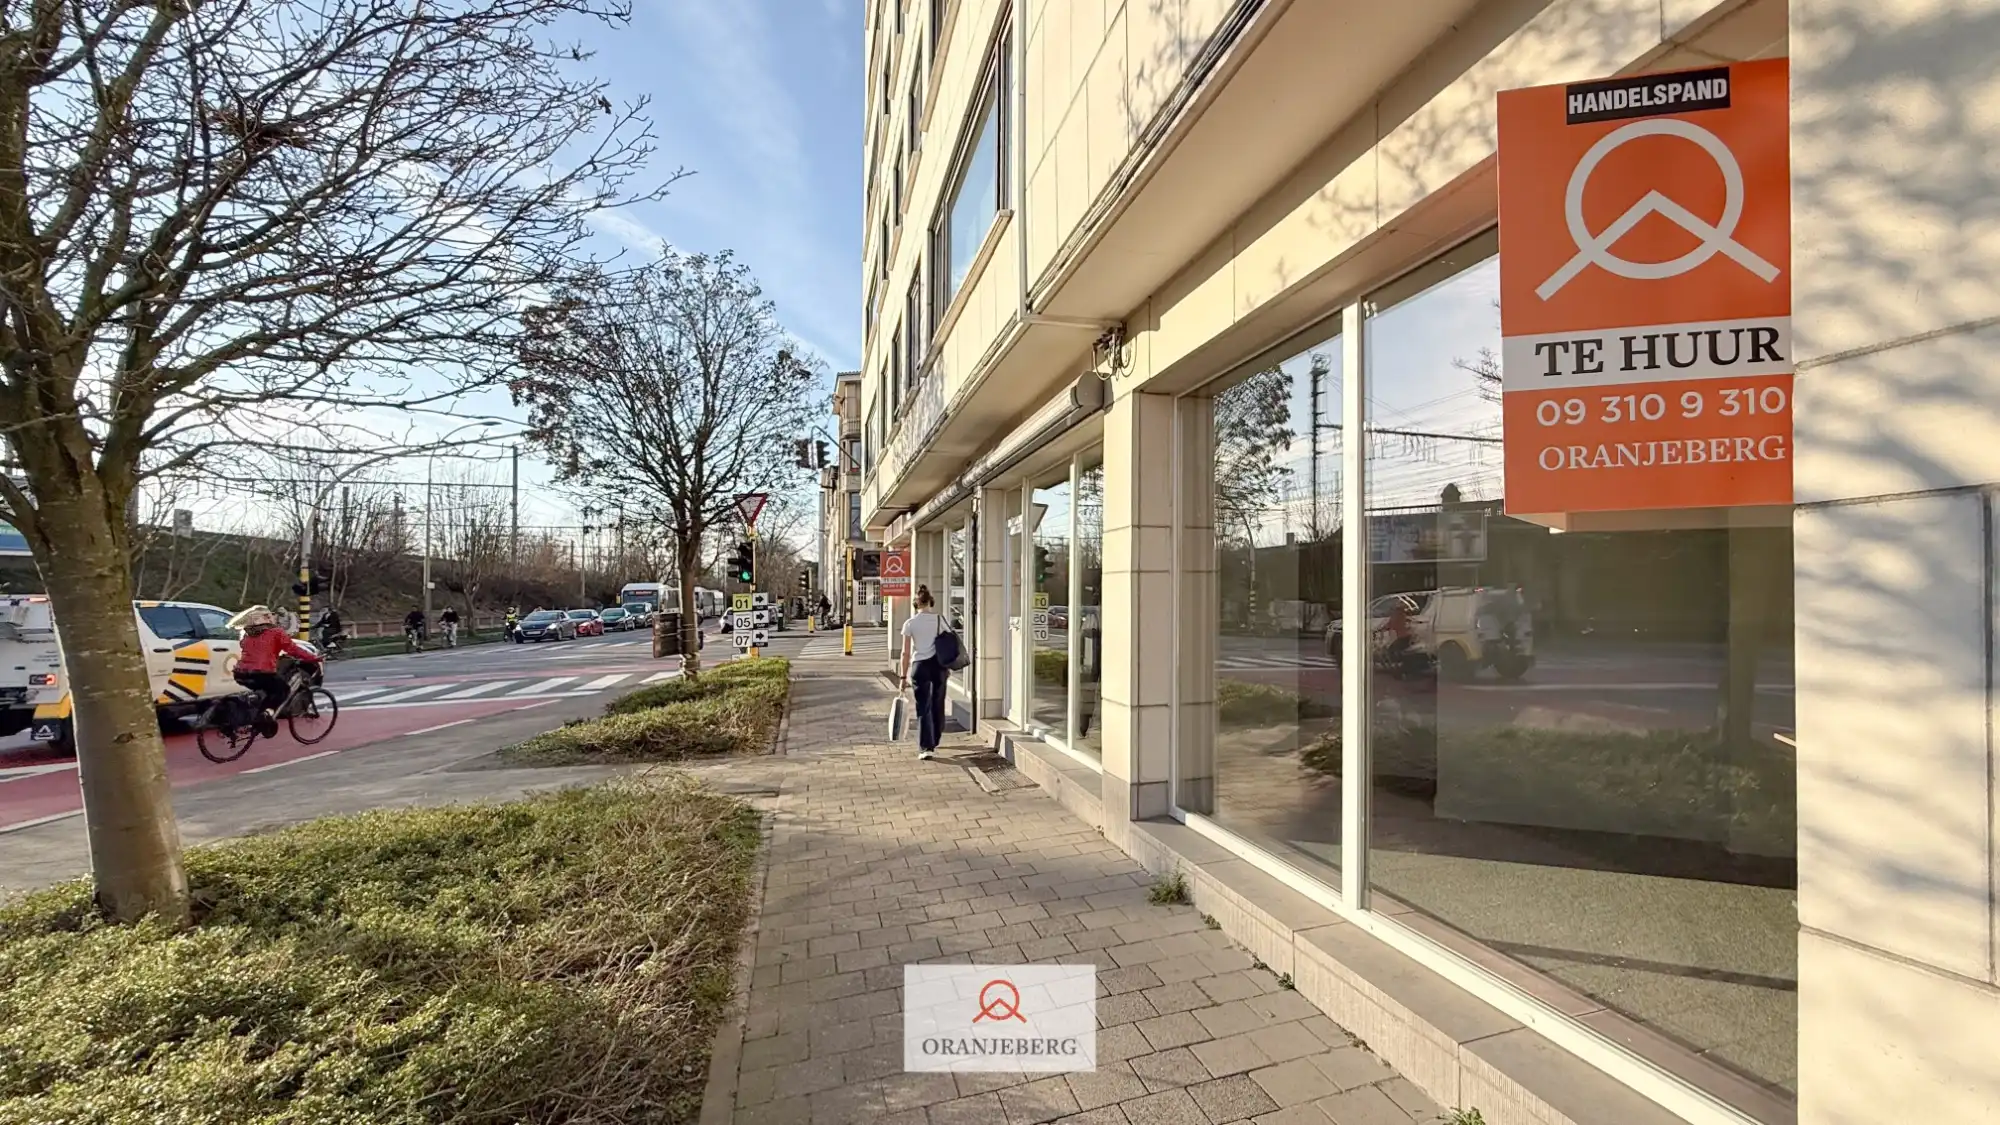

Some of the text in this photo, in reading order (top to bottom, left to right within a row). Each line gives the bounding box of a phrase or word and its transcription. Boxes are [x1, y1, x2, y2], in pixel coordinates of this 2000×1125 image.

[1568, 78, 1728, 115] HANDELSPAND
[1534, 327, 1785, 377] TE HUUR
[1536, 386, 1786, 427] 09 310 9 310
[1538, 435, 1786, 471] ORANJEBERG
[735, 598, 749, 610] 01
[735, 635, 750, 646] 07
[736, 617, 751, 628] 05
